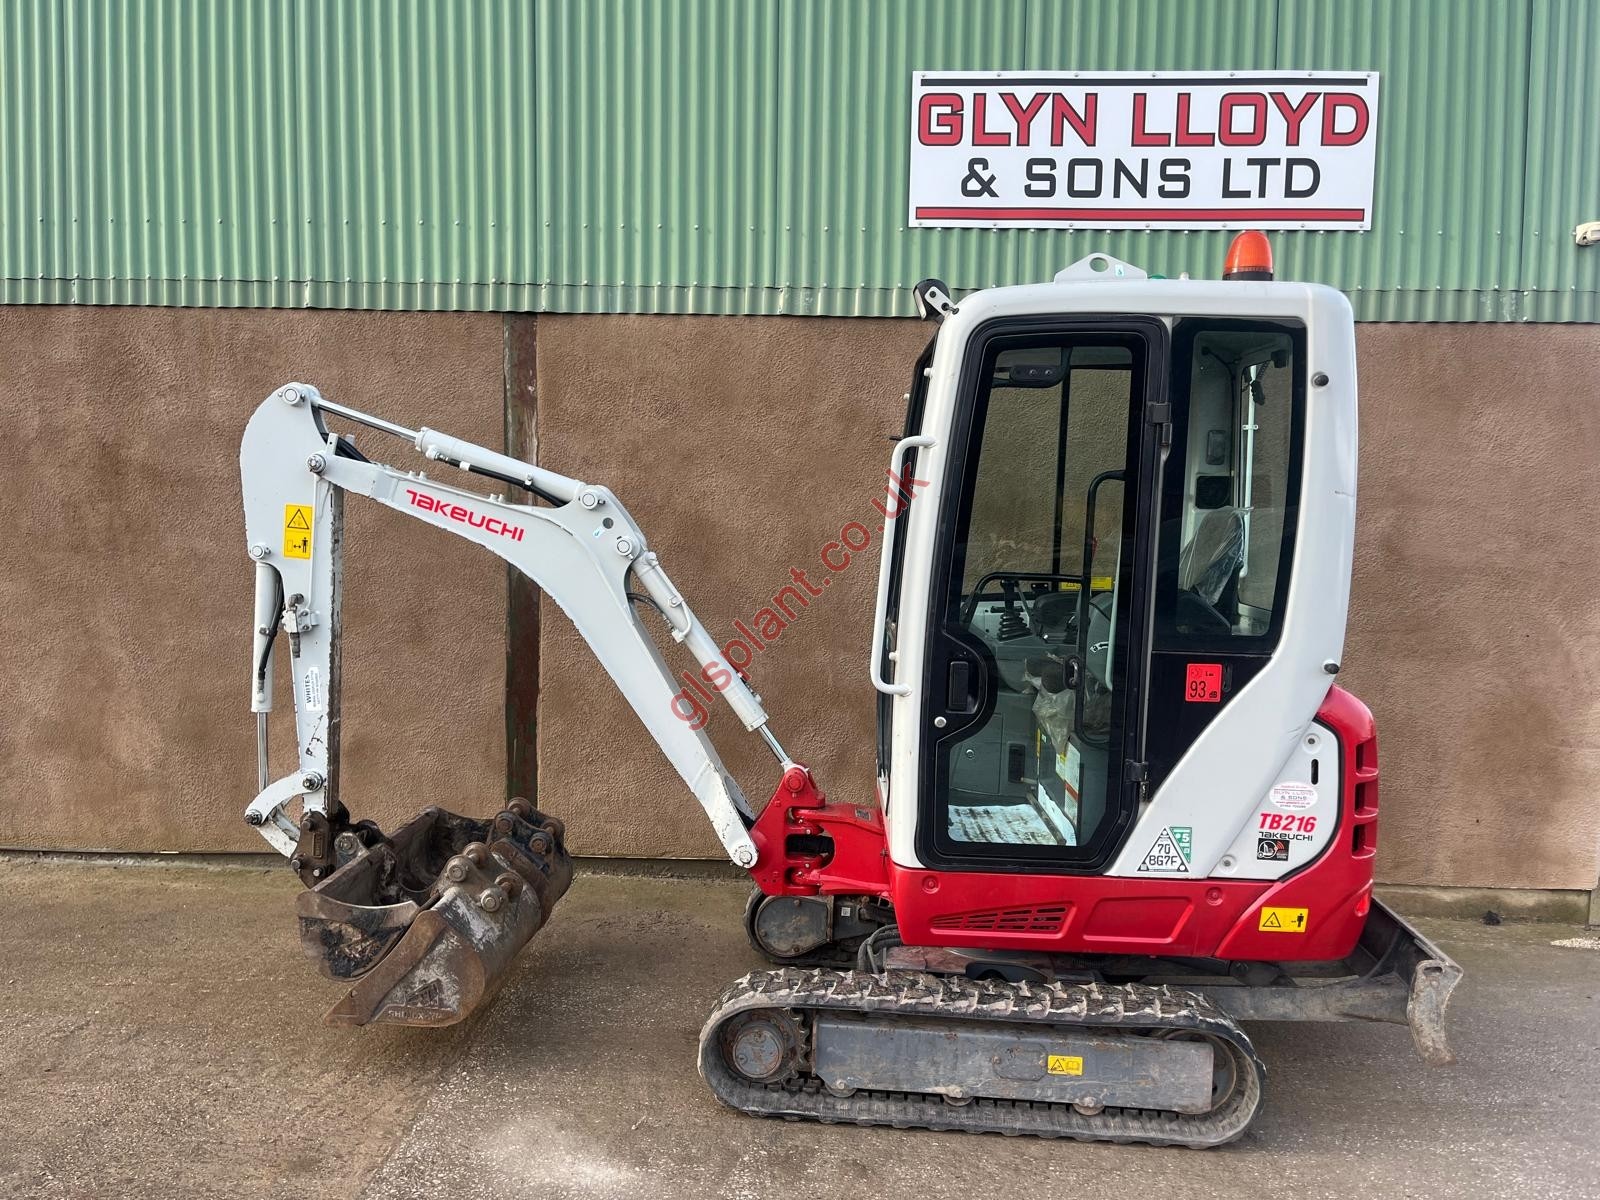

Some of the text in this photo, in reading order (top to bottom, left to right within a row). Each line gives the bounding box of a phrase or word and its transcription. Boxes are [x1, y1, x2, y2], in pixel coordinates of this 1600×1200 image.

[917, 92, 1370, 147] GLYN LLOYD
[960, 157, 1321, 198] & SONS LTD
[1190, 680, 1206, 698] 93
[1259, 813, 1317, 833] TB216
[1157, 843, 1171, 855] 70
